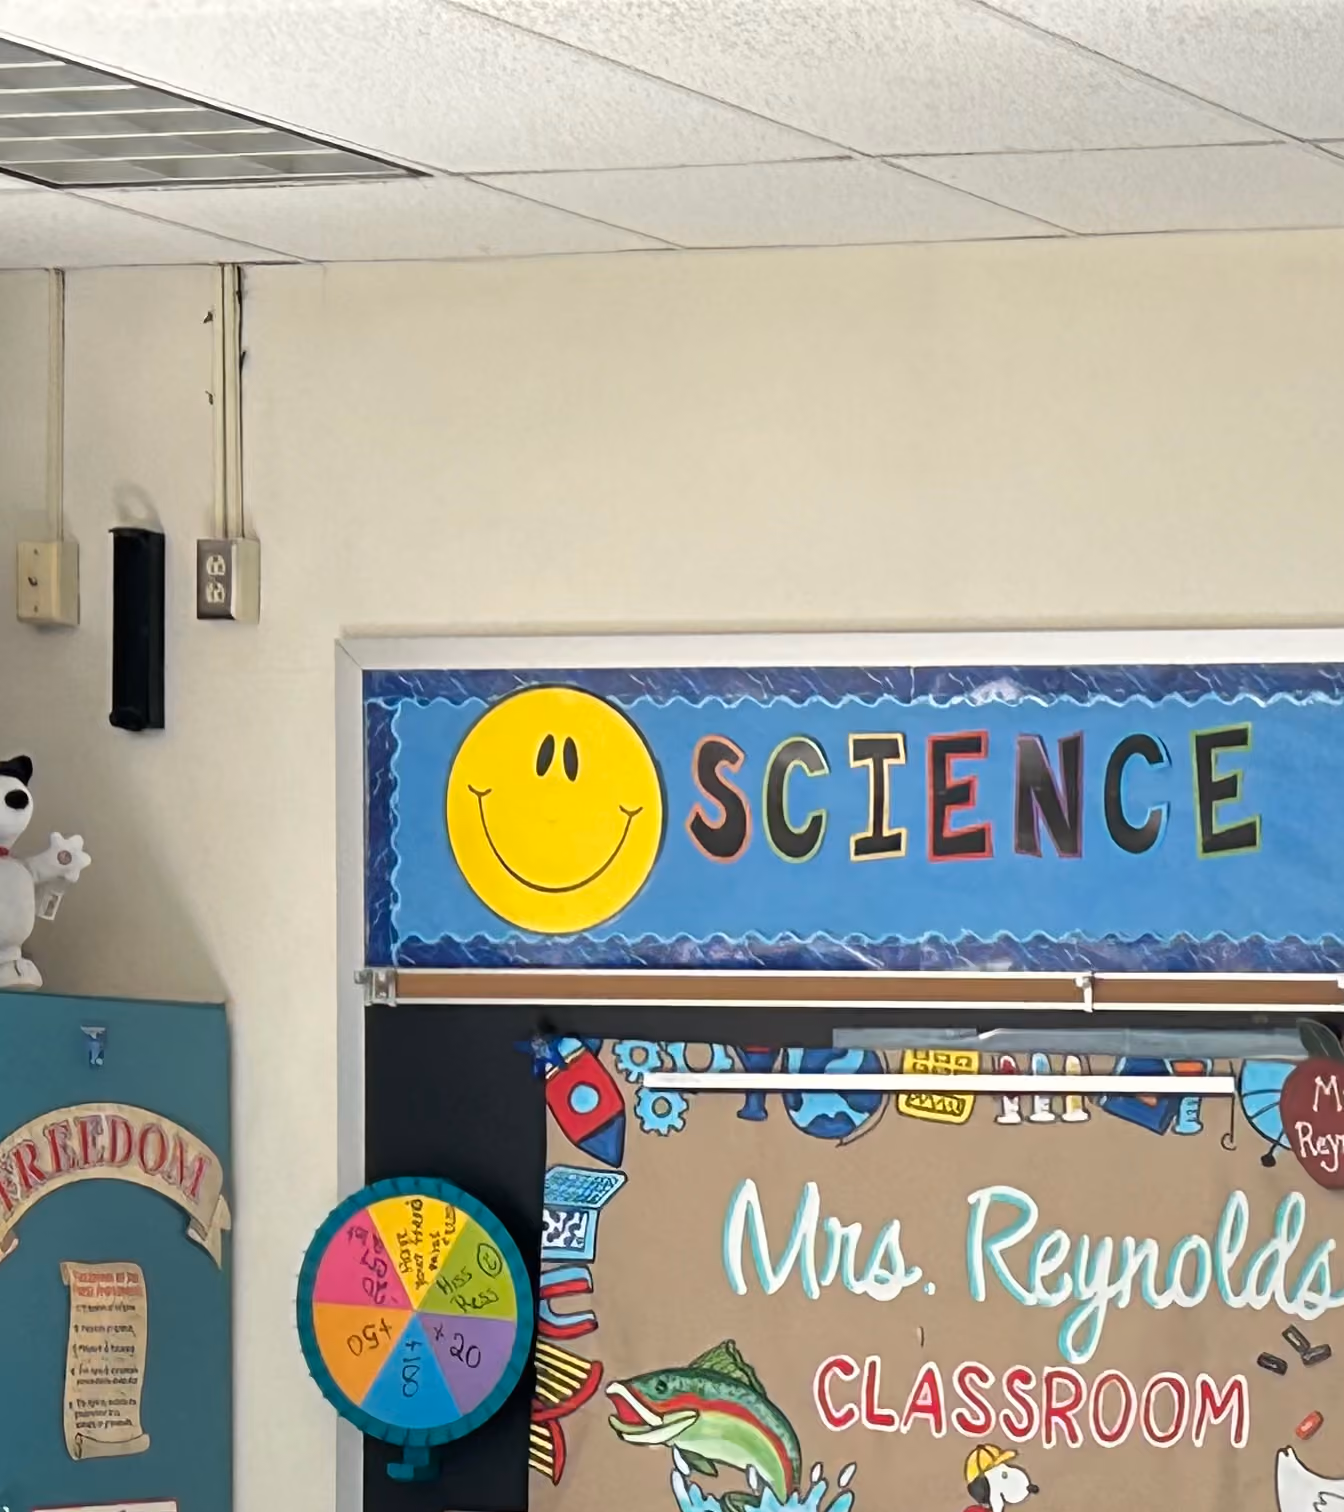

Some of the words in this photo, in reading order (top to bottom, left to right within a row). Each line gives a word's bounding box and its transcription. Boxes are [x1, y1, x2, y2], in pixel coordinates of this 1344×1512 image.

[685, 721, 1261, 863] SCIENCE
[722, 1178, 936, 1301] Mrs.
[813, 1354, 1250, 1448] CLASSROOM
